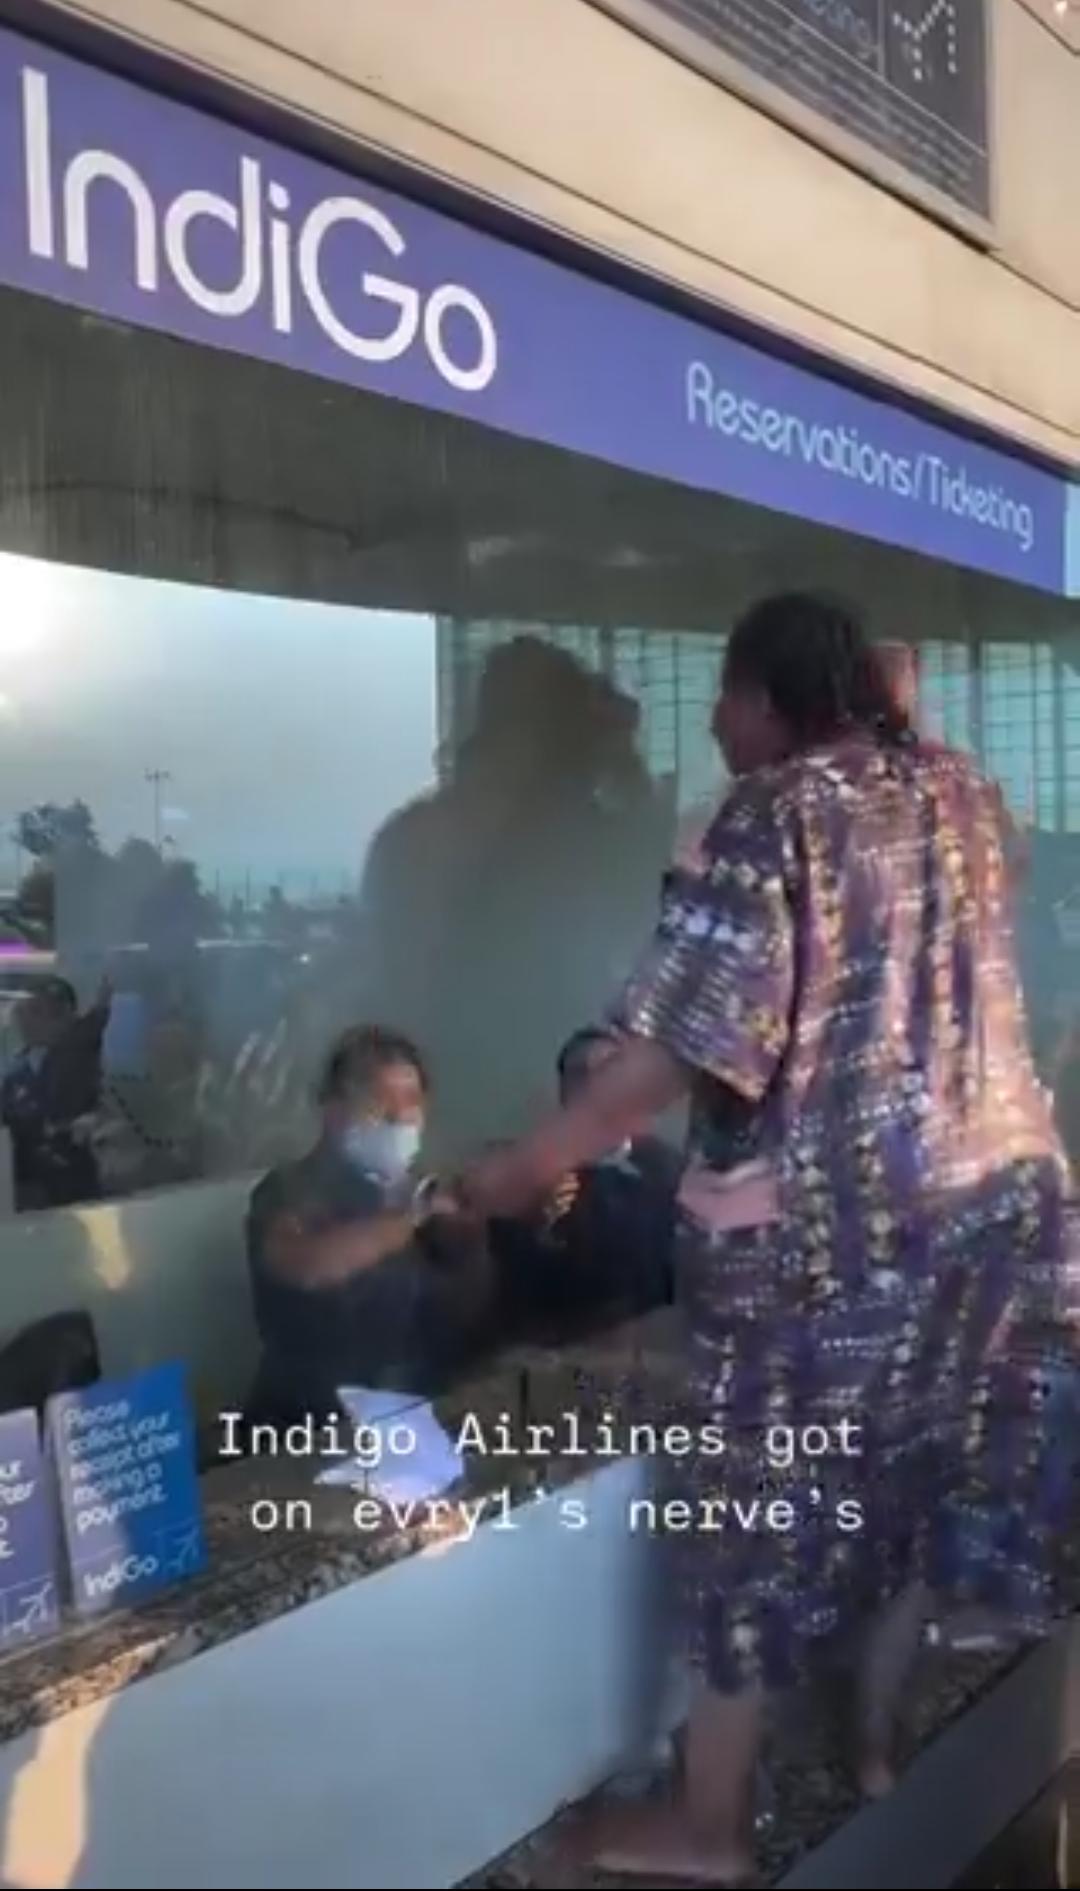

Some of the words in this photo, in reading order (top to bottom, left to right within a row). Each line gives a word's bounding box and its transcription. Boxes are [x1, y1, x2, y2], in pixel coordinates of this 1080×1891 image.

[22, 66, 497, 391] IndiGo
[686, 361, 1035, 552] Reservations/Ticketing
[65, 1401, 128, 1434] Please
[68, 1423, 128, 1457] collect
[130, 1410, 170, 1440] your
[70, 1446, 136, 1480] receipt
[137, 1433, 180, 1458] after
[73, 1467, 145, 1503] making
[83, 1555, 159, 1596] IndiGo
